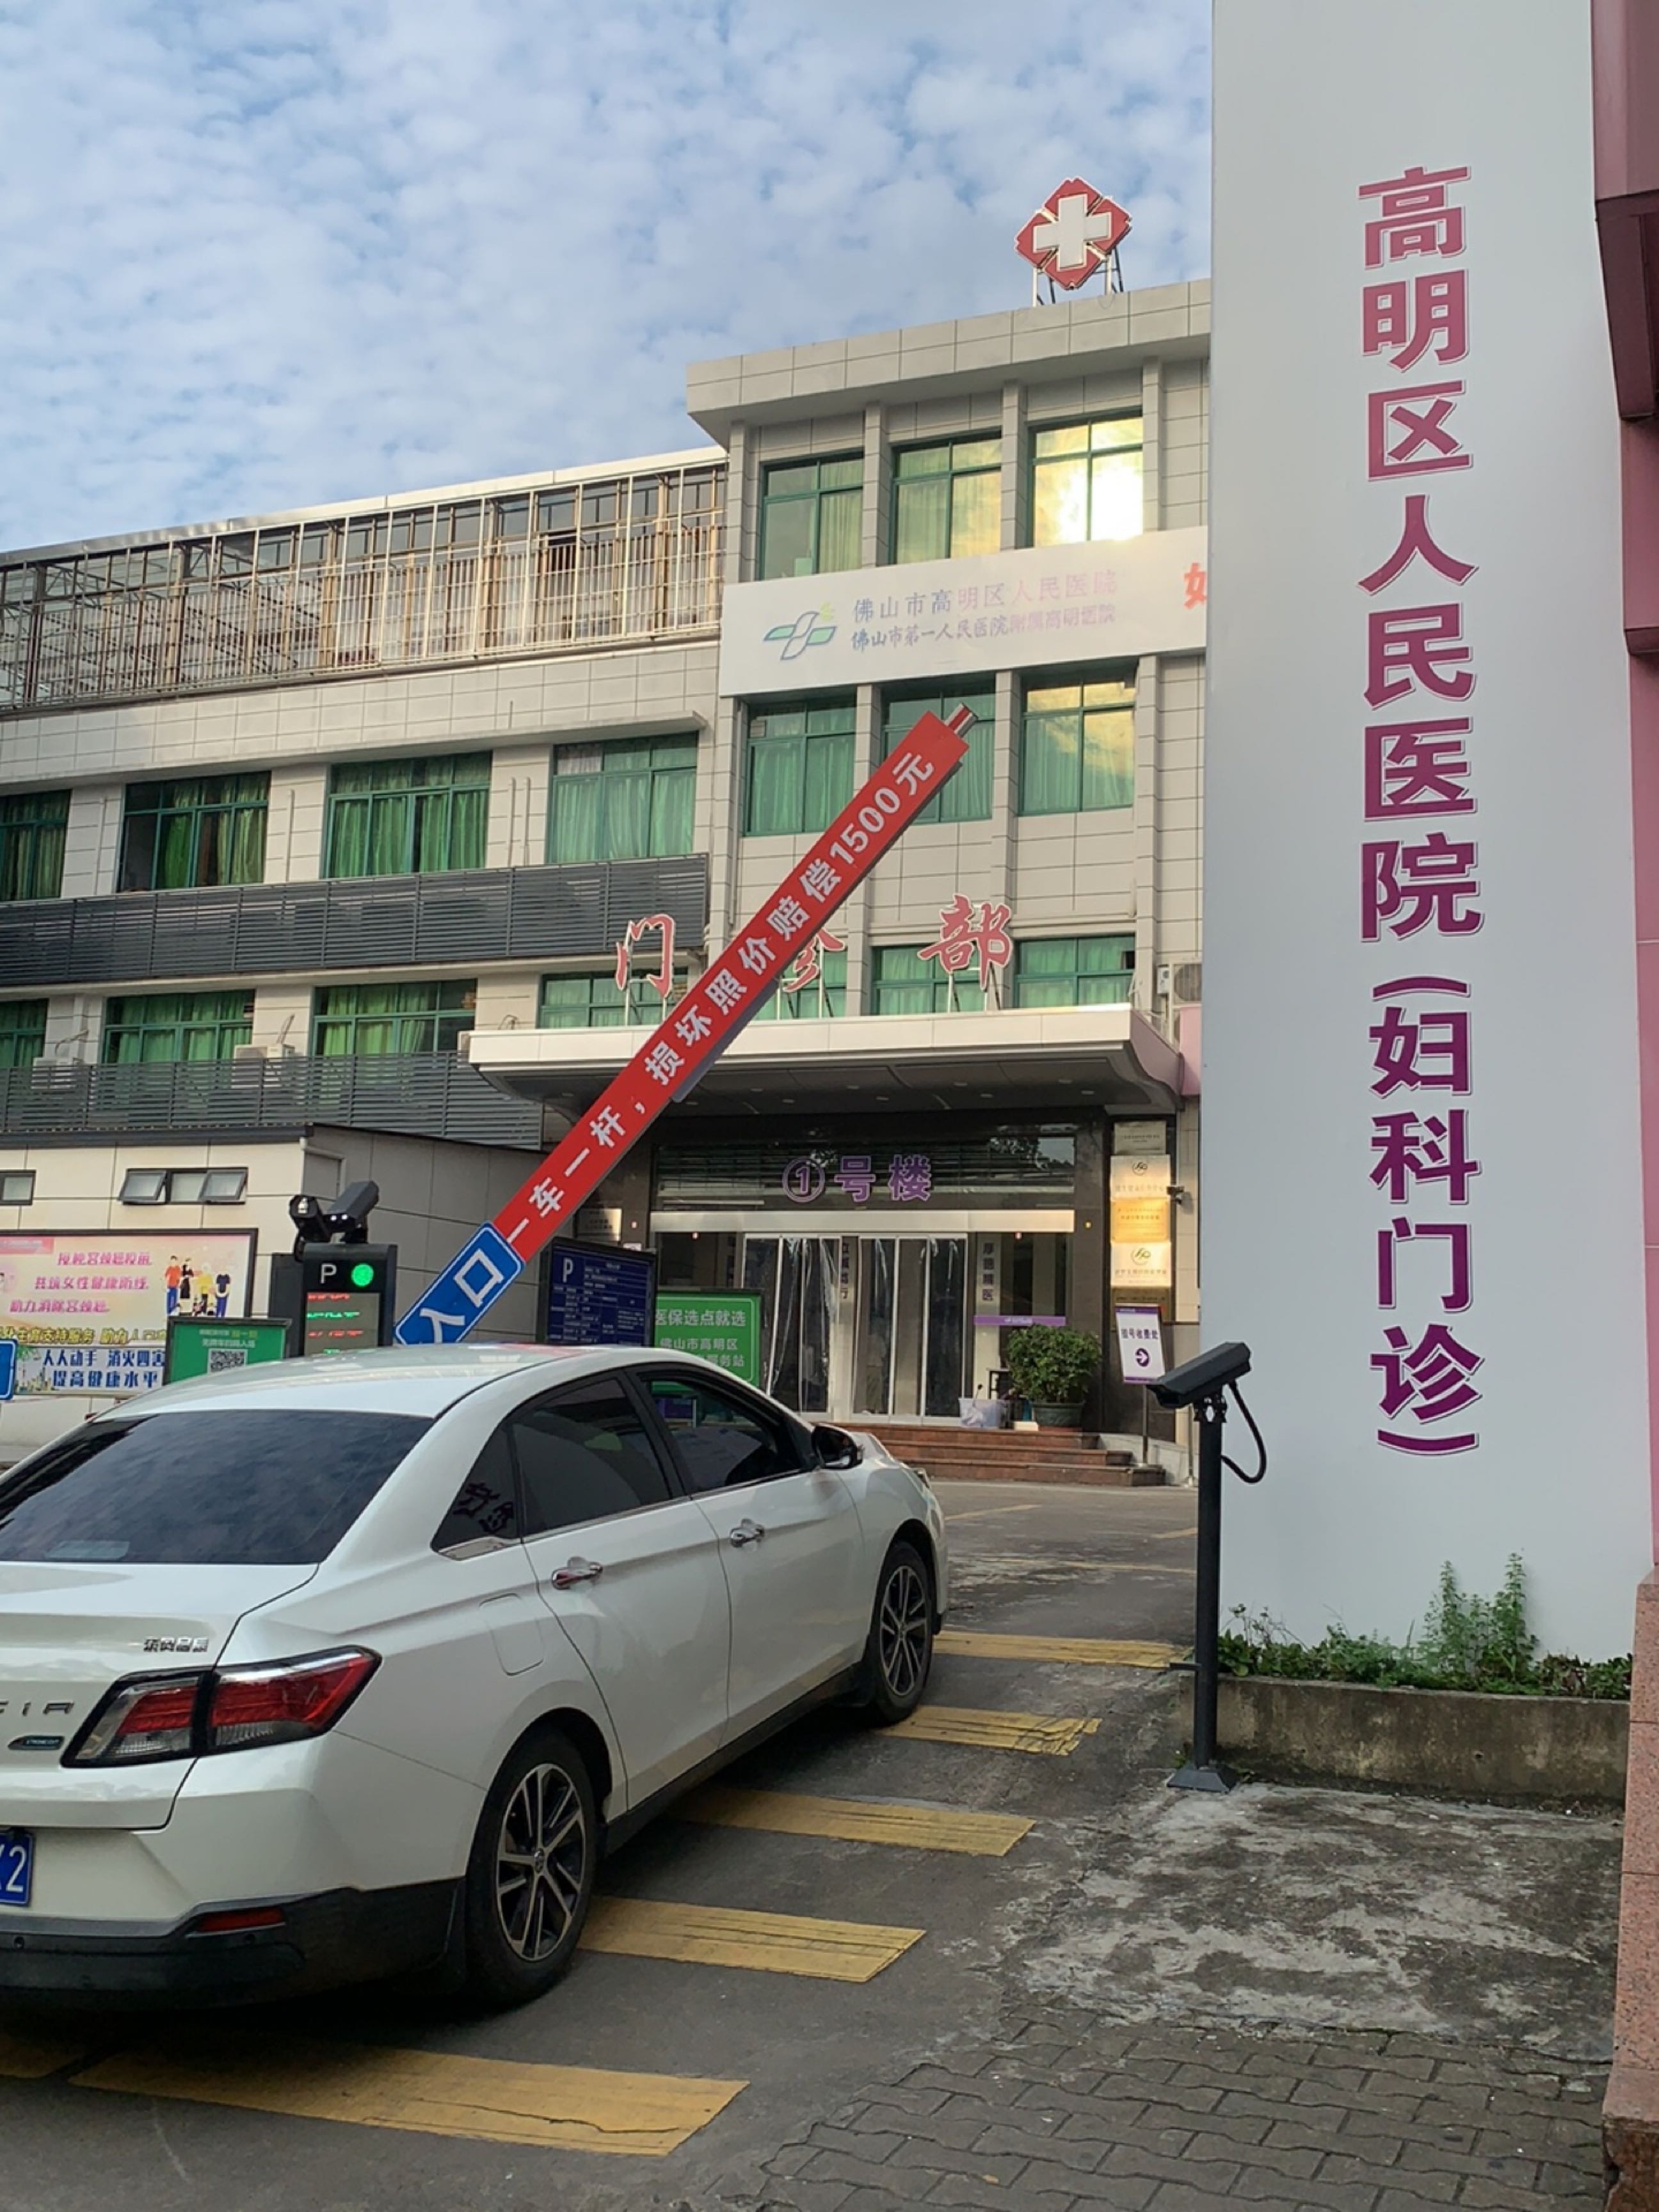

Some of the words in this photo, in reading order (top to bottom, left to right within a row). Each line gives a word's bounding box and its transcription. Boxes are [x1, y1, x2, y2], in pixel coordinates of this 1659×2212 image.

[853, 568, 1118, 625] 佛山市高明区人民医院
[321, 1263, 337, 1284] P
[563, 1257, 573, 1283] P
[419, 1248, 504, 1343] 入口
[655, 1308, 746, 1327] 医保选点就选
[659, 1337, 739, 1350] 佛山市高明区
[42, 1349, 97, 1366] 人人动手
[53, 1370, 157, 1388] 提高健康水平
[0, 1699, 75, 1717] IA
